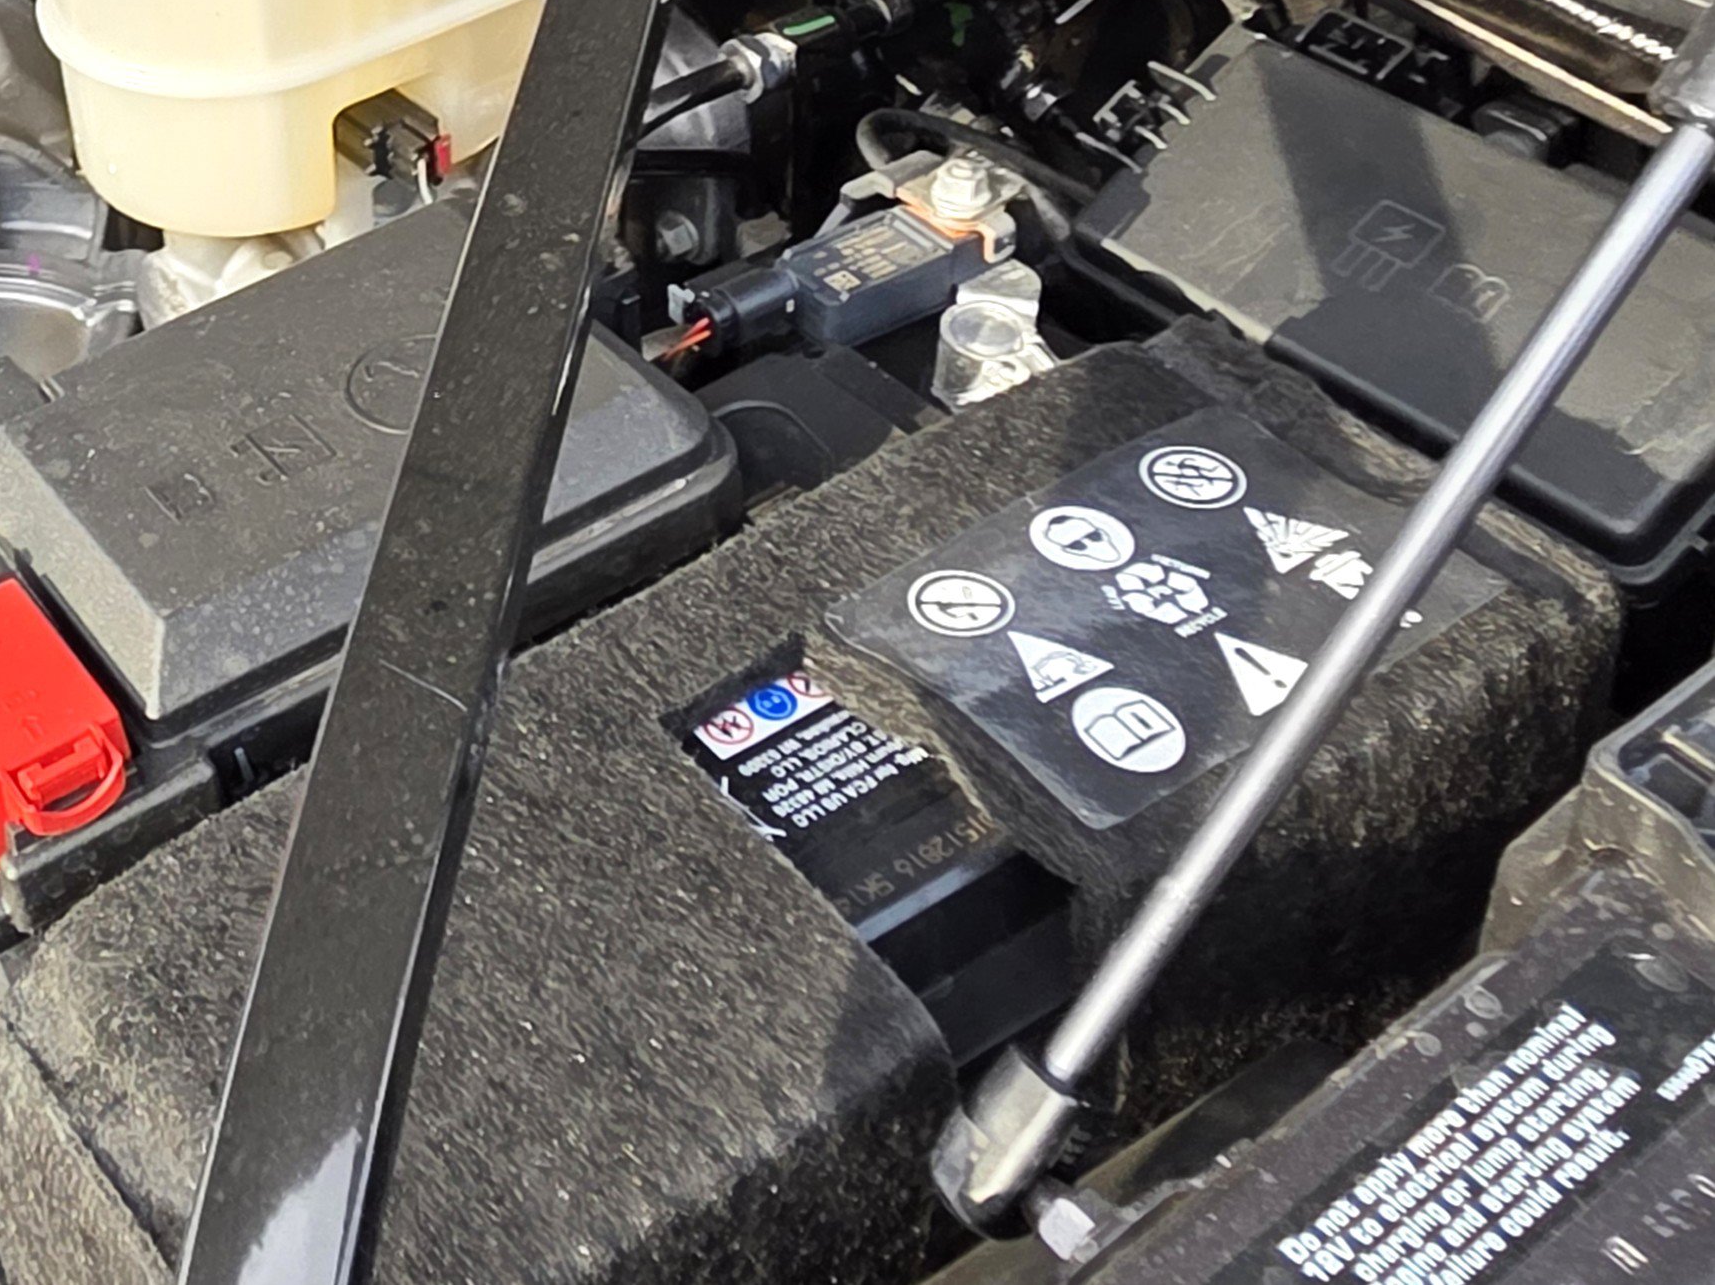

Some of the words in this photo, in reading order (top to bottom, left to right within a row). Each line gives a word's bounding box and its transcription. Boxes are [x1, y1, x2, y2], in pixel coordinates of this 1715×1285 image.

[770, 755, 803, 778] LLC
[791, 806, 827, 828] LLC
[845, 775, 879, 799] FCA
[1277, 1228, 1321, 1265] Do
[1314, 1196, 1360, 1237] not
[1353, 1147, 1417, 1206] apply
[1407, 1108, 1466, 1159] more
[1454, 1070, 1514, 1116] than
[1504, 1002, 1587, 1076] nominal
[1349, 1217, 1385, 1246] to
[1377, 1132, 1478, 1223] electrical
[1471, 1076, 1549, 1144] system
[1542, 1022, 1617, 1083] during
[1441, 1203, 1487, 1248] and
[1479, 1134, 1575, 1216] starting
[1571, 1075, 1642, 1138] system
[1353, 1201, 1452, 1284] charging
[1441, 1179, 1473, 1208] or
[1462, 1138, 1526, 1188] jump
[1503, 1179, 1563, 1241] could
